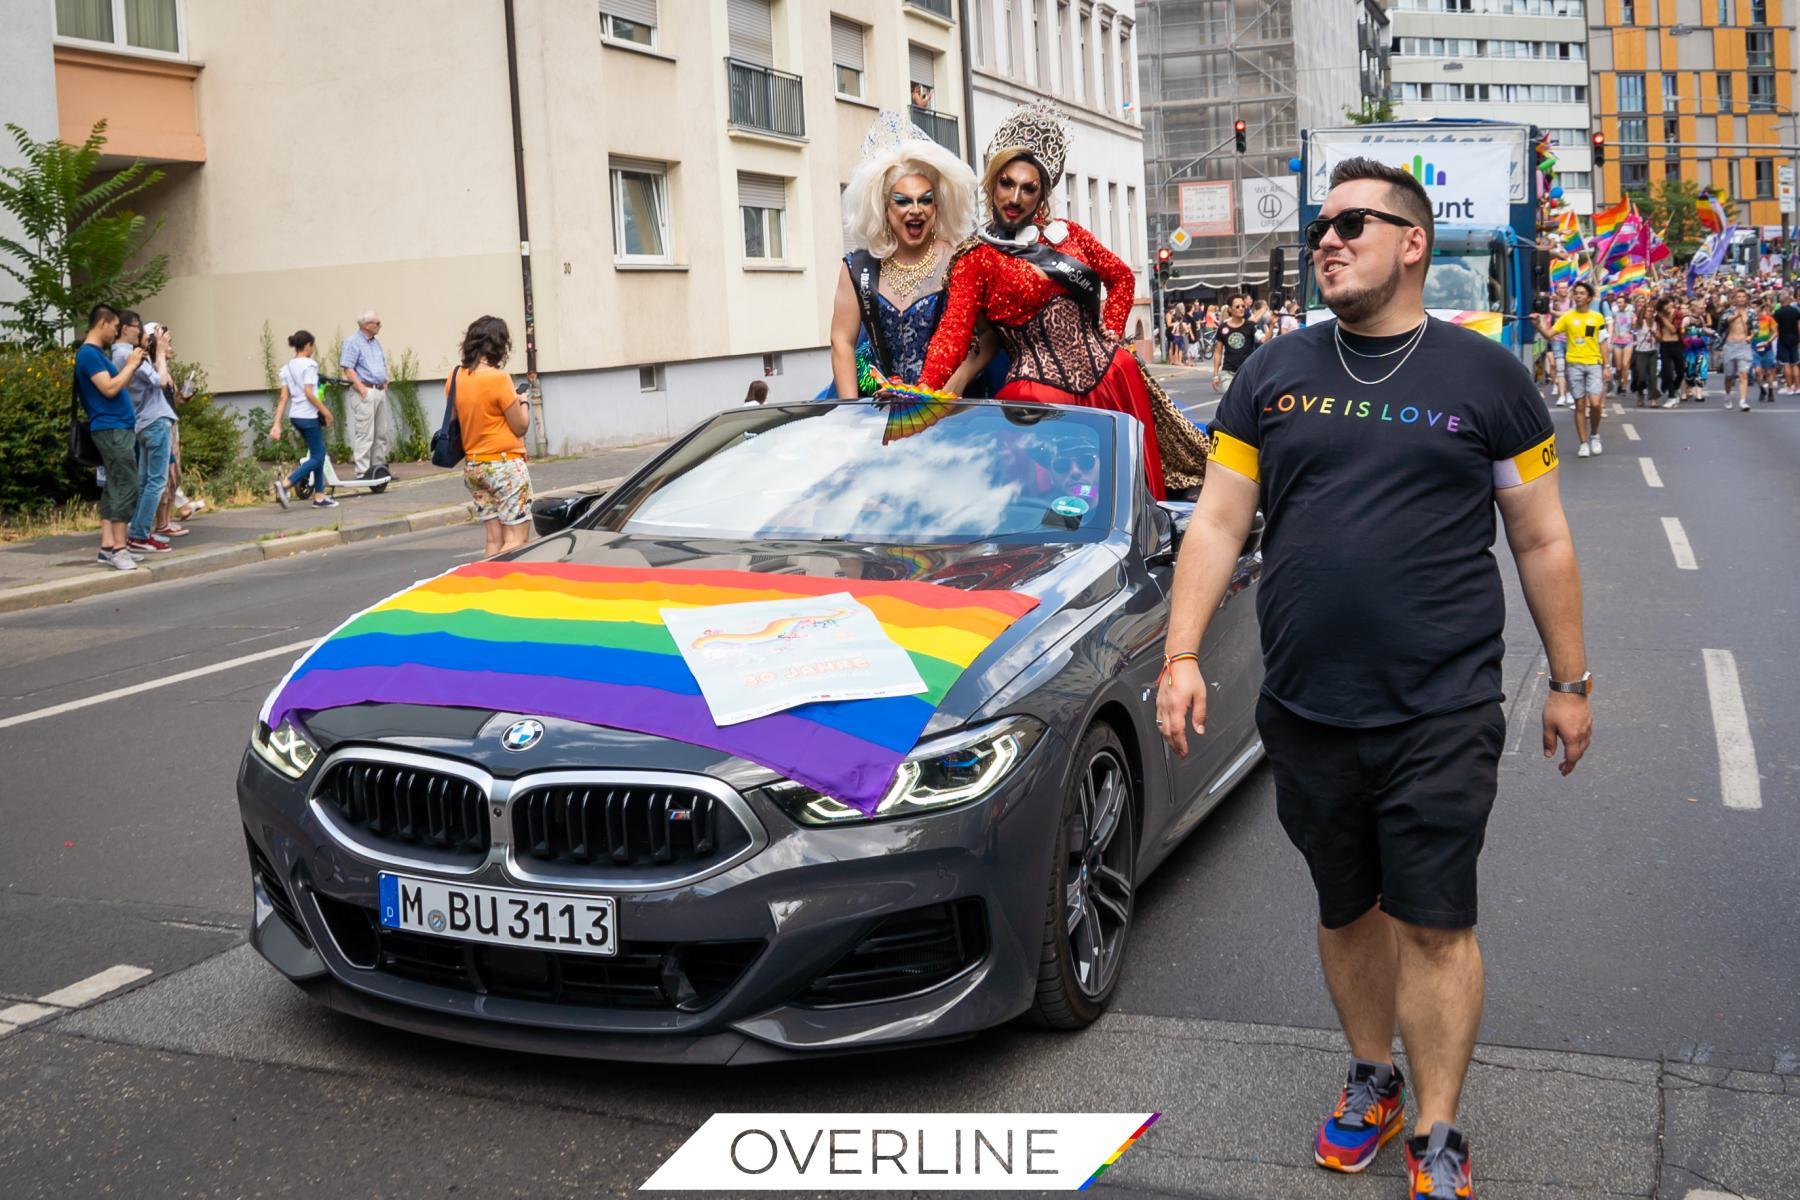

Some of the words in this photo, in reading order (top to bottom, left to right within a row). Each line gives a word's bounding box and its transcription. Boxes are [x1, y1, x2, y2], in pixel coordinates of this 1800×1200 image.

[1433, 197, 1475, 218] unt
[563, 262, 572, 275] 30
[1263, 394, 1336, 414] OVE
[1343, 399, 1372, 418] IS
[1381, 403, 1461, 433] LOVE
[386, 905, 395, 919] D
[401, 883, 424, 926] M
[507, 898, 610, 947] 3113
